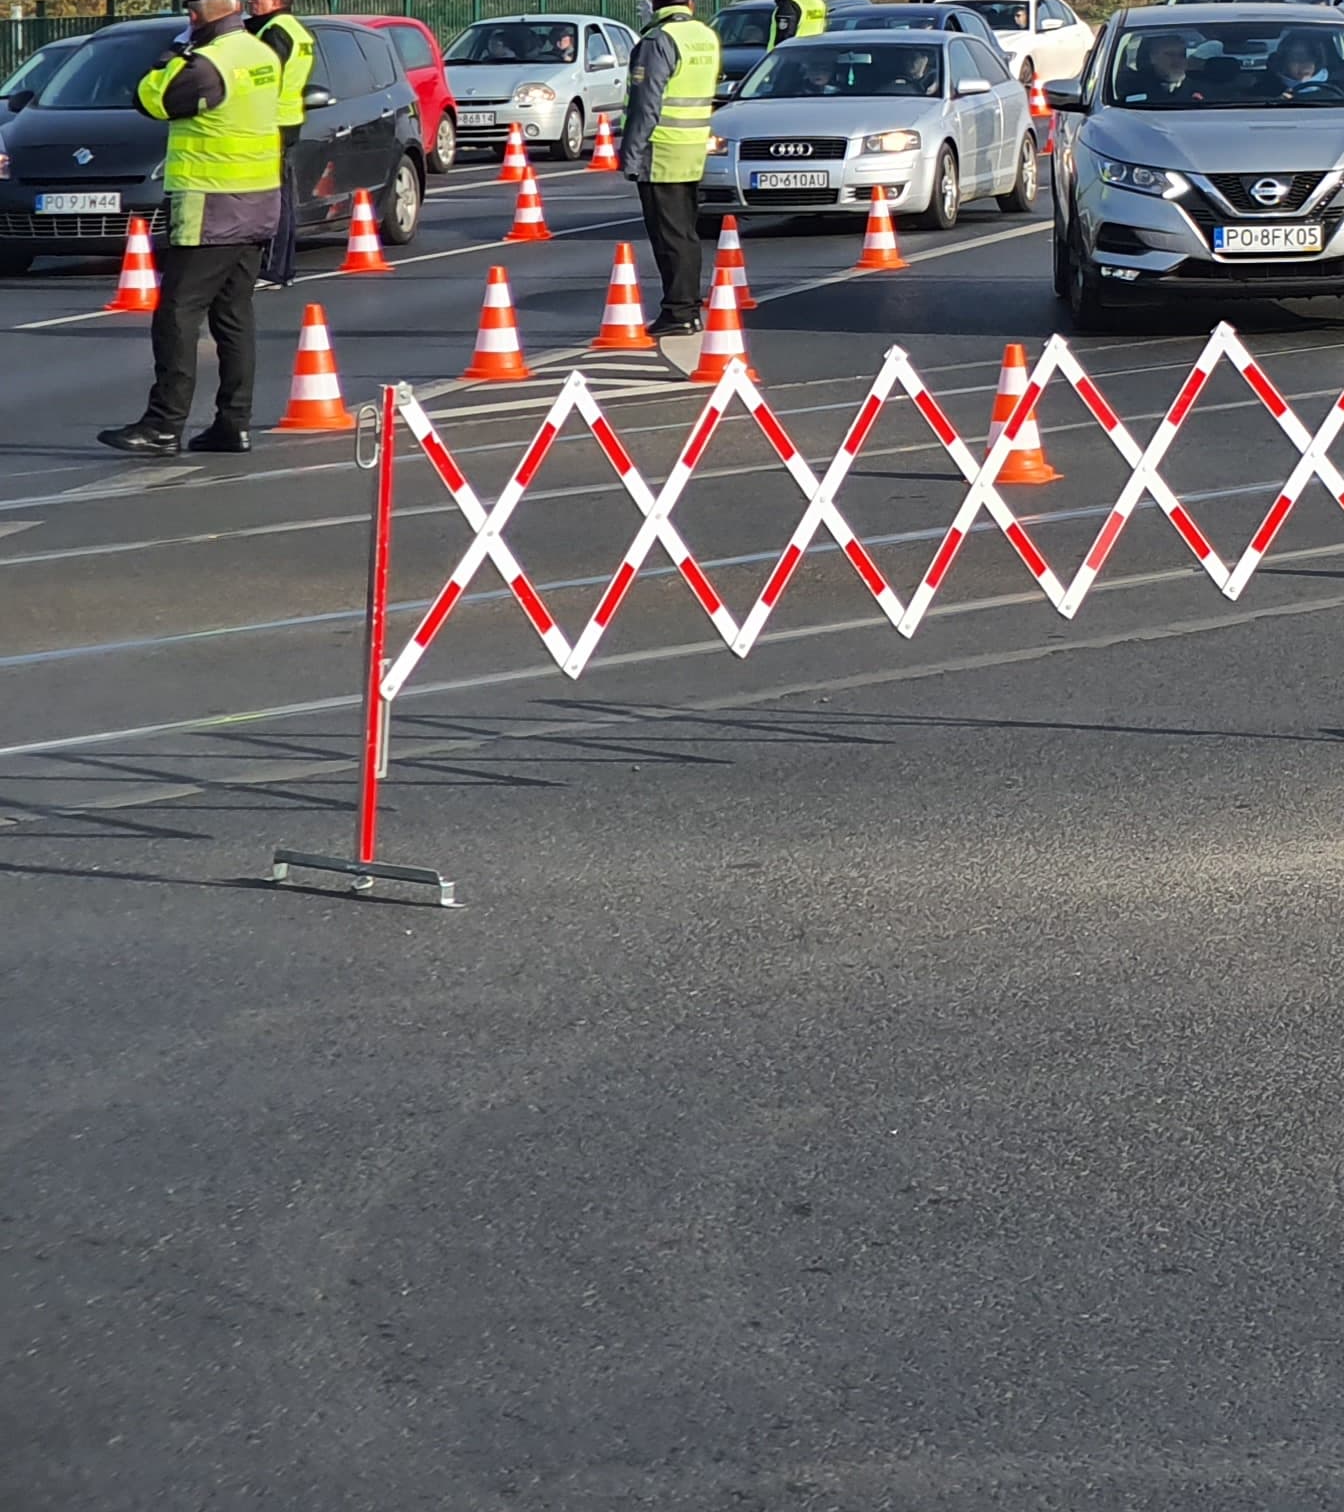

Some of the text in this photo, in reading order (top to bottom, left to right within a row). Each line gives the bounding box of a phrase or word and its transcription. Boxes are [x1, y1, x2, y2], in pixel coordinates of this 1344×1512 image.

[759, 173, 826, 187] PO 610AU
[45, 195, 65, 210] PO
[1226, 227, 1319, 247] PO 8FK05
